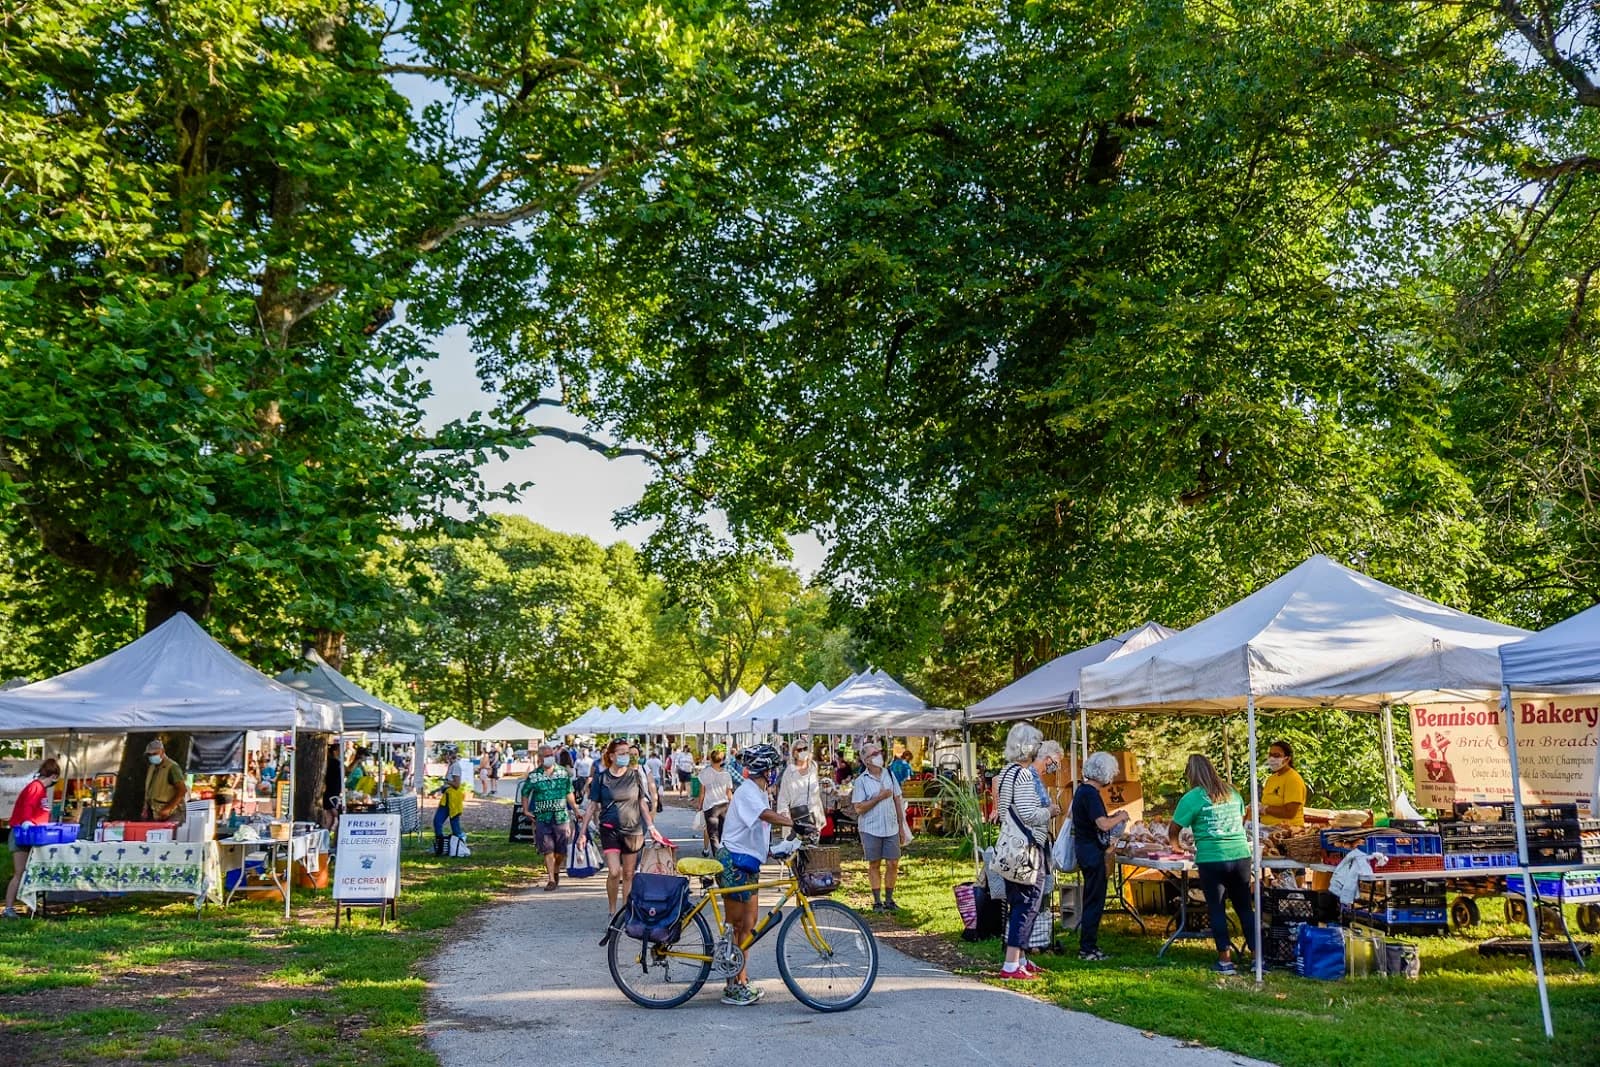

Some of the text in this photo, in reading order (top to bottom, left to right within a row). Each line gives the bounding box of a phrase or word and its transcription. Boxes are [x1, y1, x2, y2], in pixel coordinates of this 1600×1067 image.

[1415, 702, 1599, 728] Bennison' Bakery
[1456, 733, 1598, 750] Brick Oen Breads
[1556, 754, 1594, 767] Champion
[340, 837, 396, 845] BLUEBERRIES
[341, 877, 388, 885] ICE CREAM
